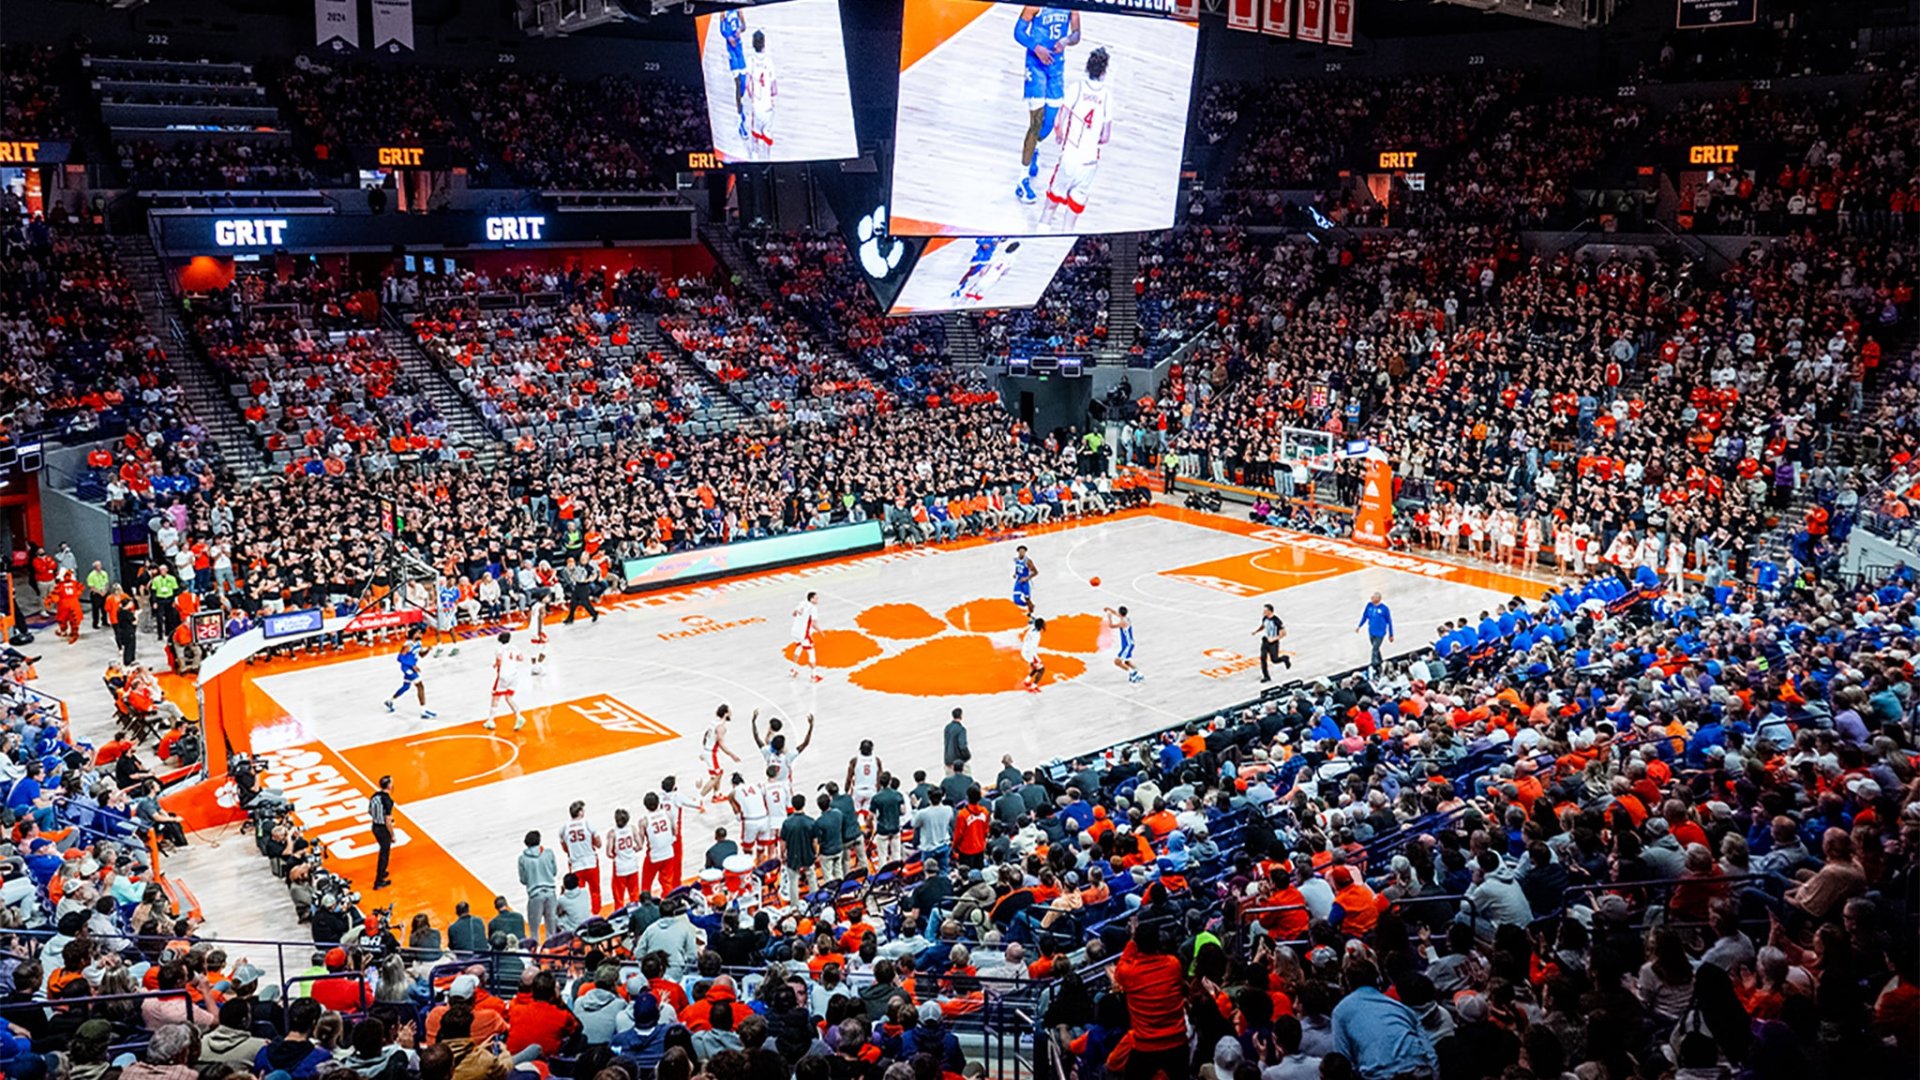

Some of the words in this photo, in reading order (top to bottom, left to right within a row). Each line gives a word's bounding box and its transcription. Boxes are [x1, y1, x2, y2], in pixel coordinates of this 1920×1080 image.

[148, 34, 168, 45] 232
[1049, 24, 1061, 40] 15
[1617, 86, 1636, 96] 222
[0, 141, 39, 162] RIT
[377, 147, 424, 165] GRIT
[1689, 144, 1738, 164] GRIT
[1379, 151, 1418, 168] GRIT
[215, 219, 287, 246] GRIT
[486, 216, 545, 240] GRIT
[200, 625, 217, 638] 26
[772, 790, 781, 803] 3
[651, 819, 668, 834] 32
[568, 829, 586, 843] 35
[618, 836, 633, 850] 20
